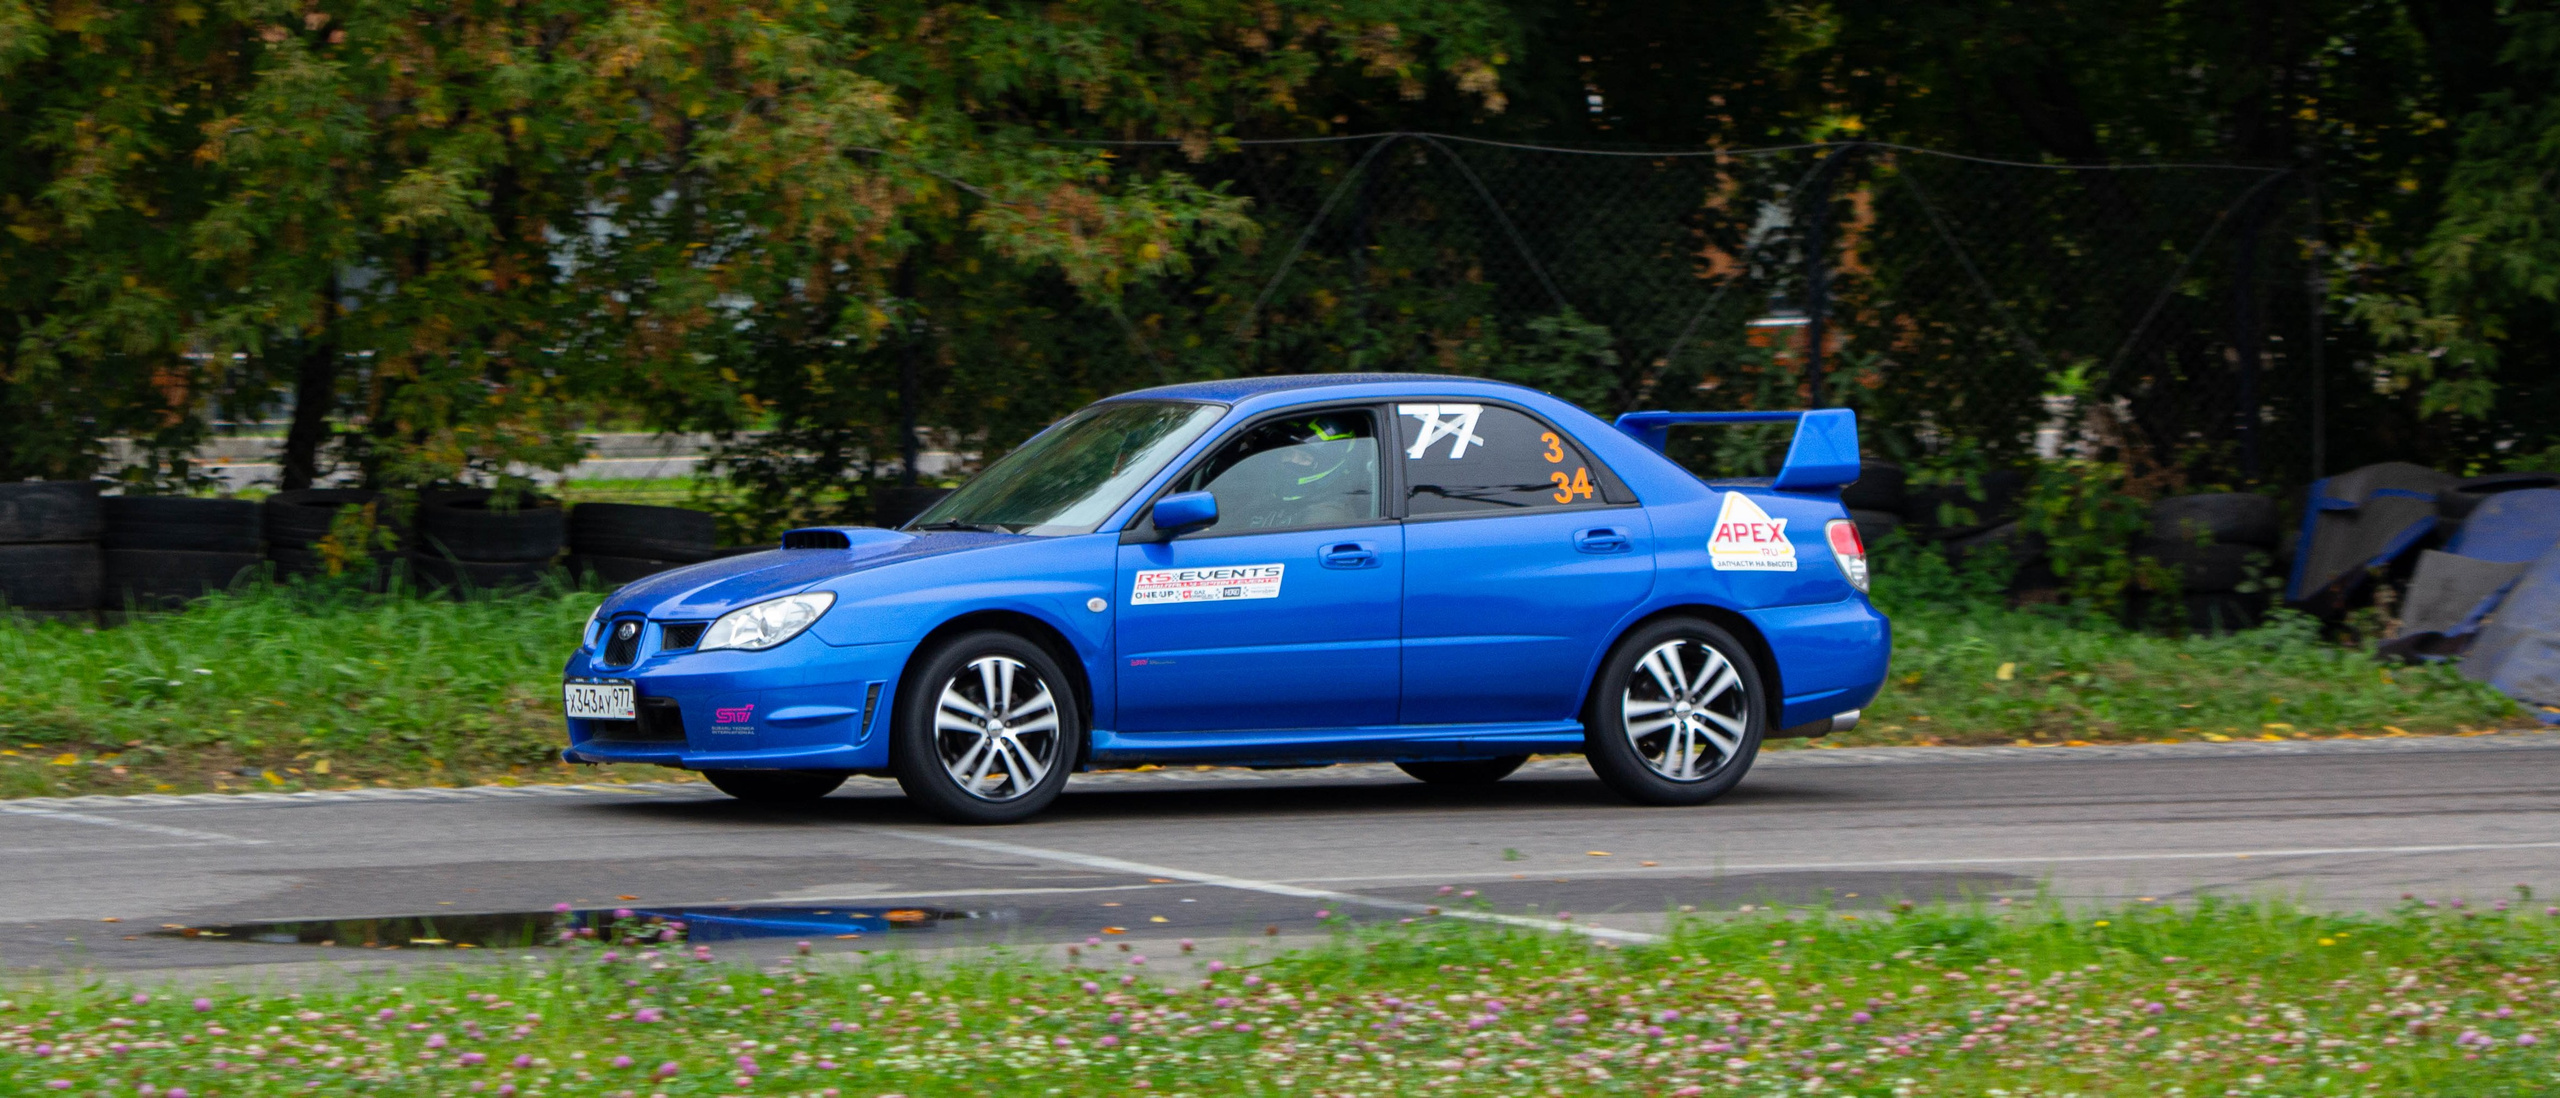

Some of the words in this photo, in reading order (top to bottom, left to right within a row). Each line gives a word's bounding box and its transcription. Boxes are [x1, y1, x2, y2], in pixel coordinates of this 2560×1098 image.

[1397, 403, 1484, 460] 77
[1540, 432, 1564, 463] 3
[1550, 467, 1594, 504] 34
[1715, 522, 1784, 543] APEX
[1138, 572, 1171, 583] RS
[1179, 566, 1281, 581] EVENTS
[1717, 560, 1755, 568] ЗАПЧАСТИ
[1756, 560, 1766, 568] НА
[1767, 560, 1795, 568] ВЫСОТЕ
[613, 687, 630, 708] 977
